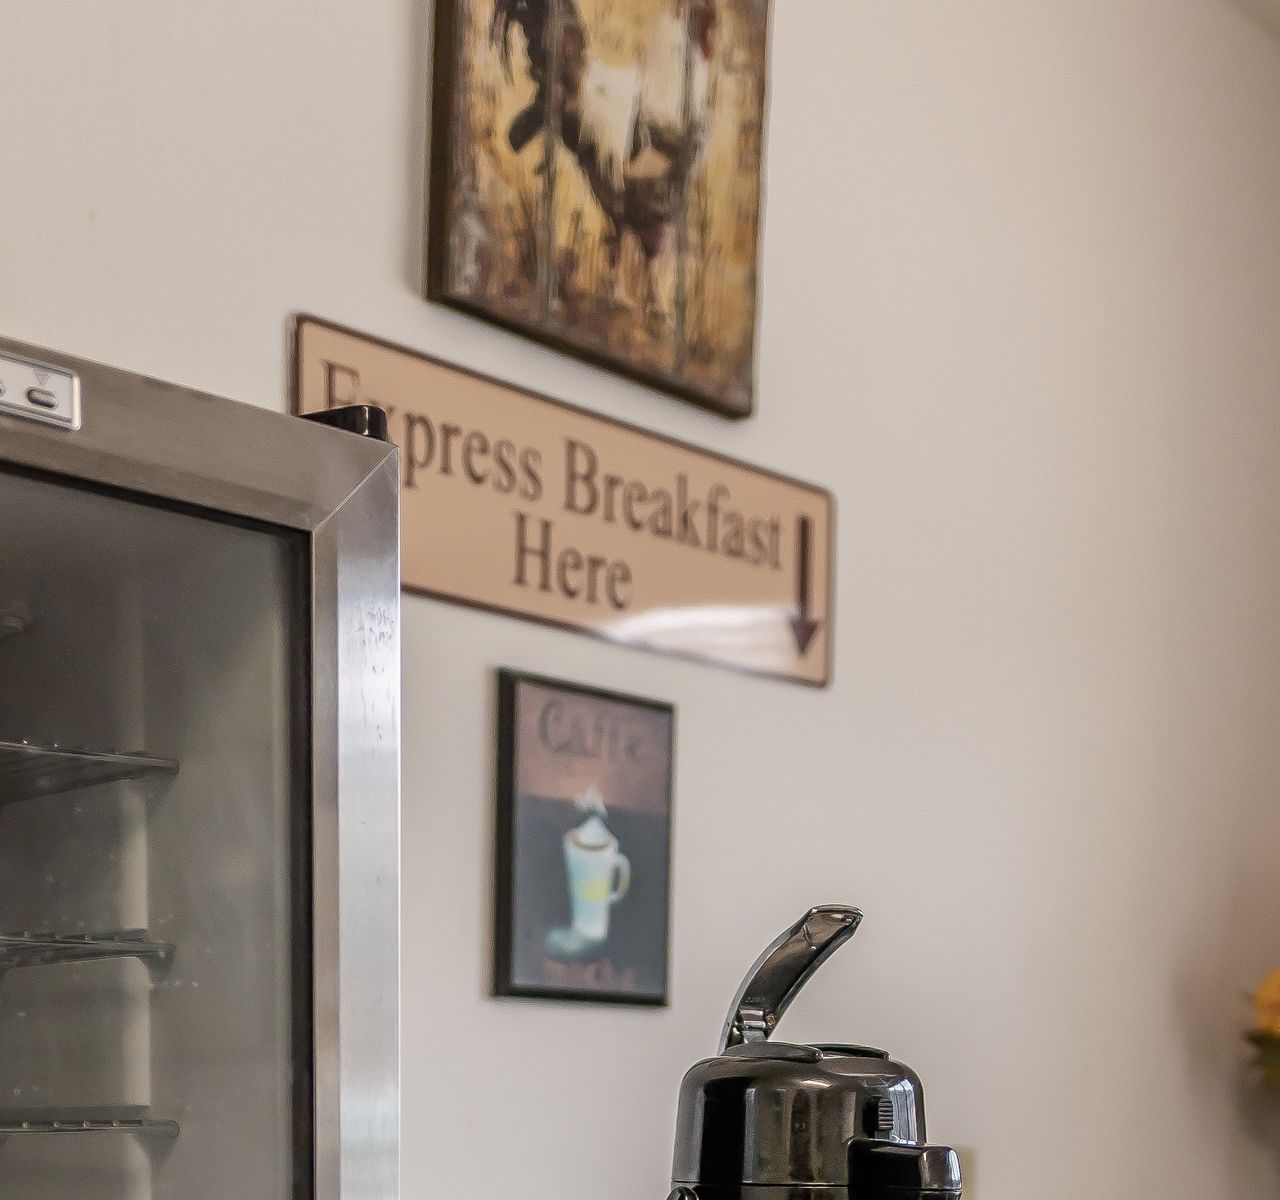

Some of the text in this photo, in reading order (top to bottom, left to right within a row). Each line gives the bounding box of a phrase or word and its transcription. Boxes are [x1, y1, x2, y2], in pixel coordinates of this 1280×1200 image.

[320, 359, 782, 570] Epress Breakfast
[511, 511, 634, 612] Here
